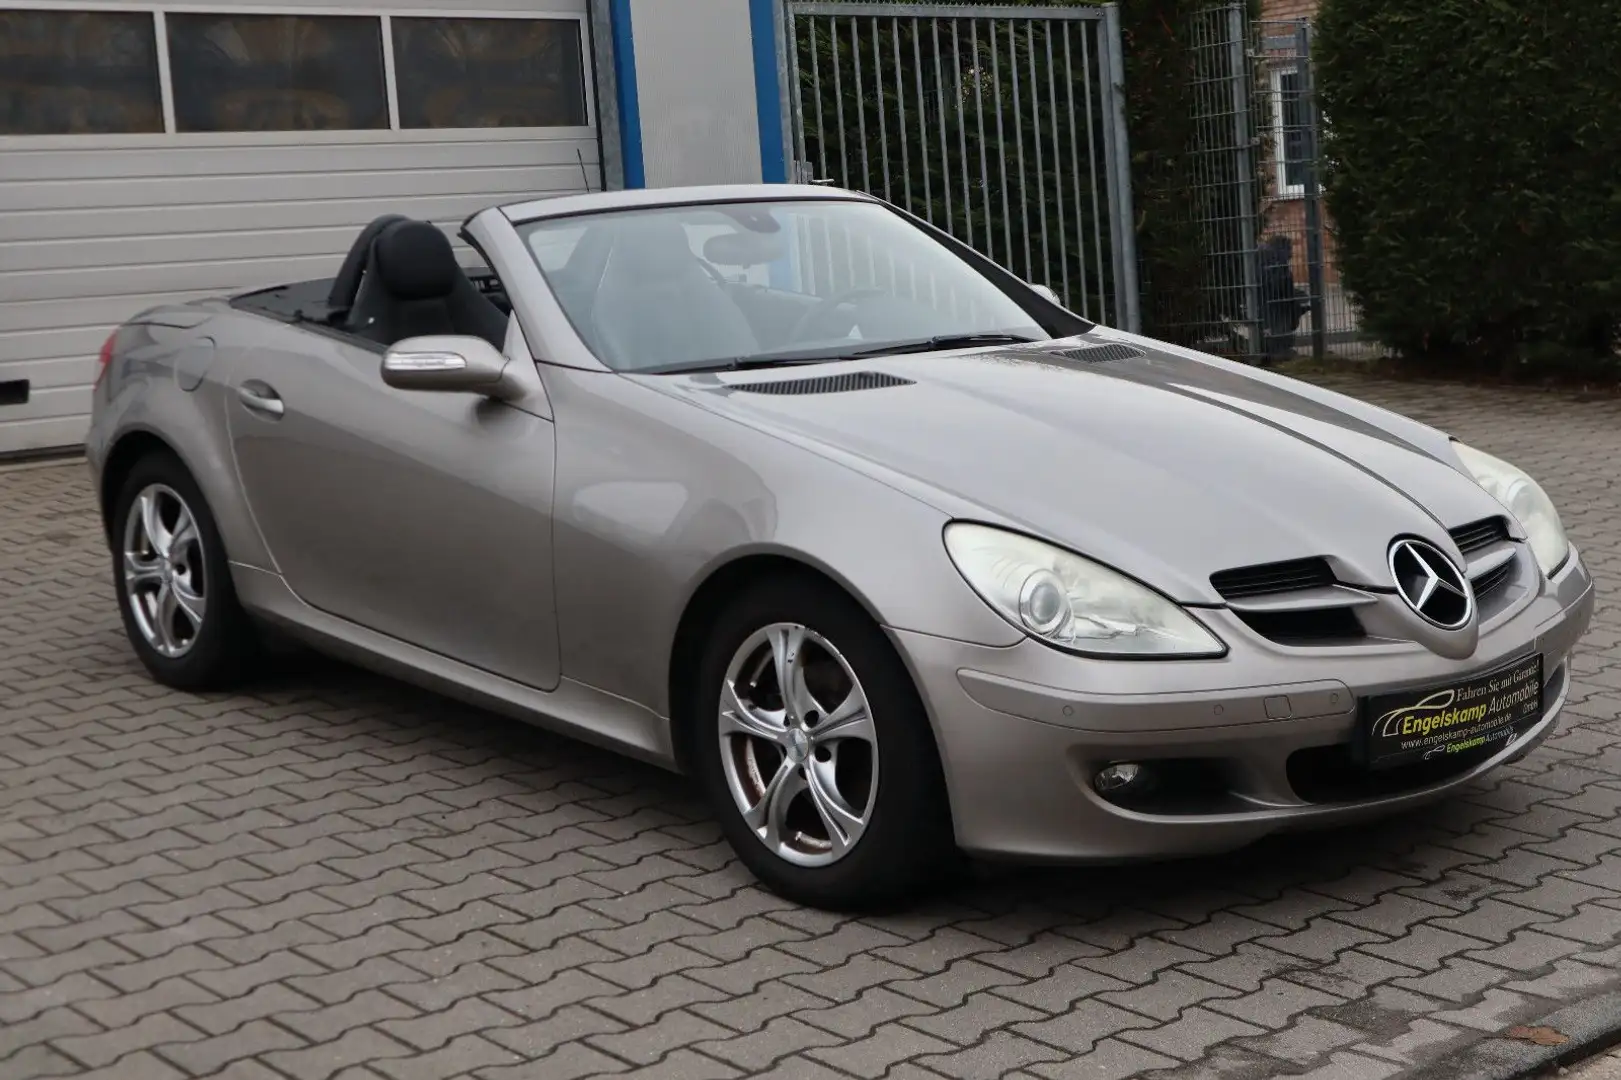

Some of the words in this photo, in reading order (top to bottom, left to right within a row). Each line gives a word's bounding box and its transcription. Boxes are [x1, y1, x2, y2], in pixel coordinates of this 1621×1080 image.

[1402, 703, 1487, 735] Engelskamp
[1488, 679, 1540, 715] Automobile
[1457, 686, 1487, 702] Fahren
[1488, 678, 1500, 693] Sie
